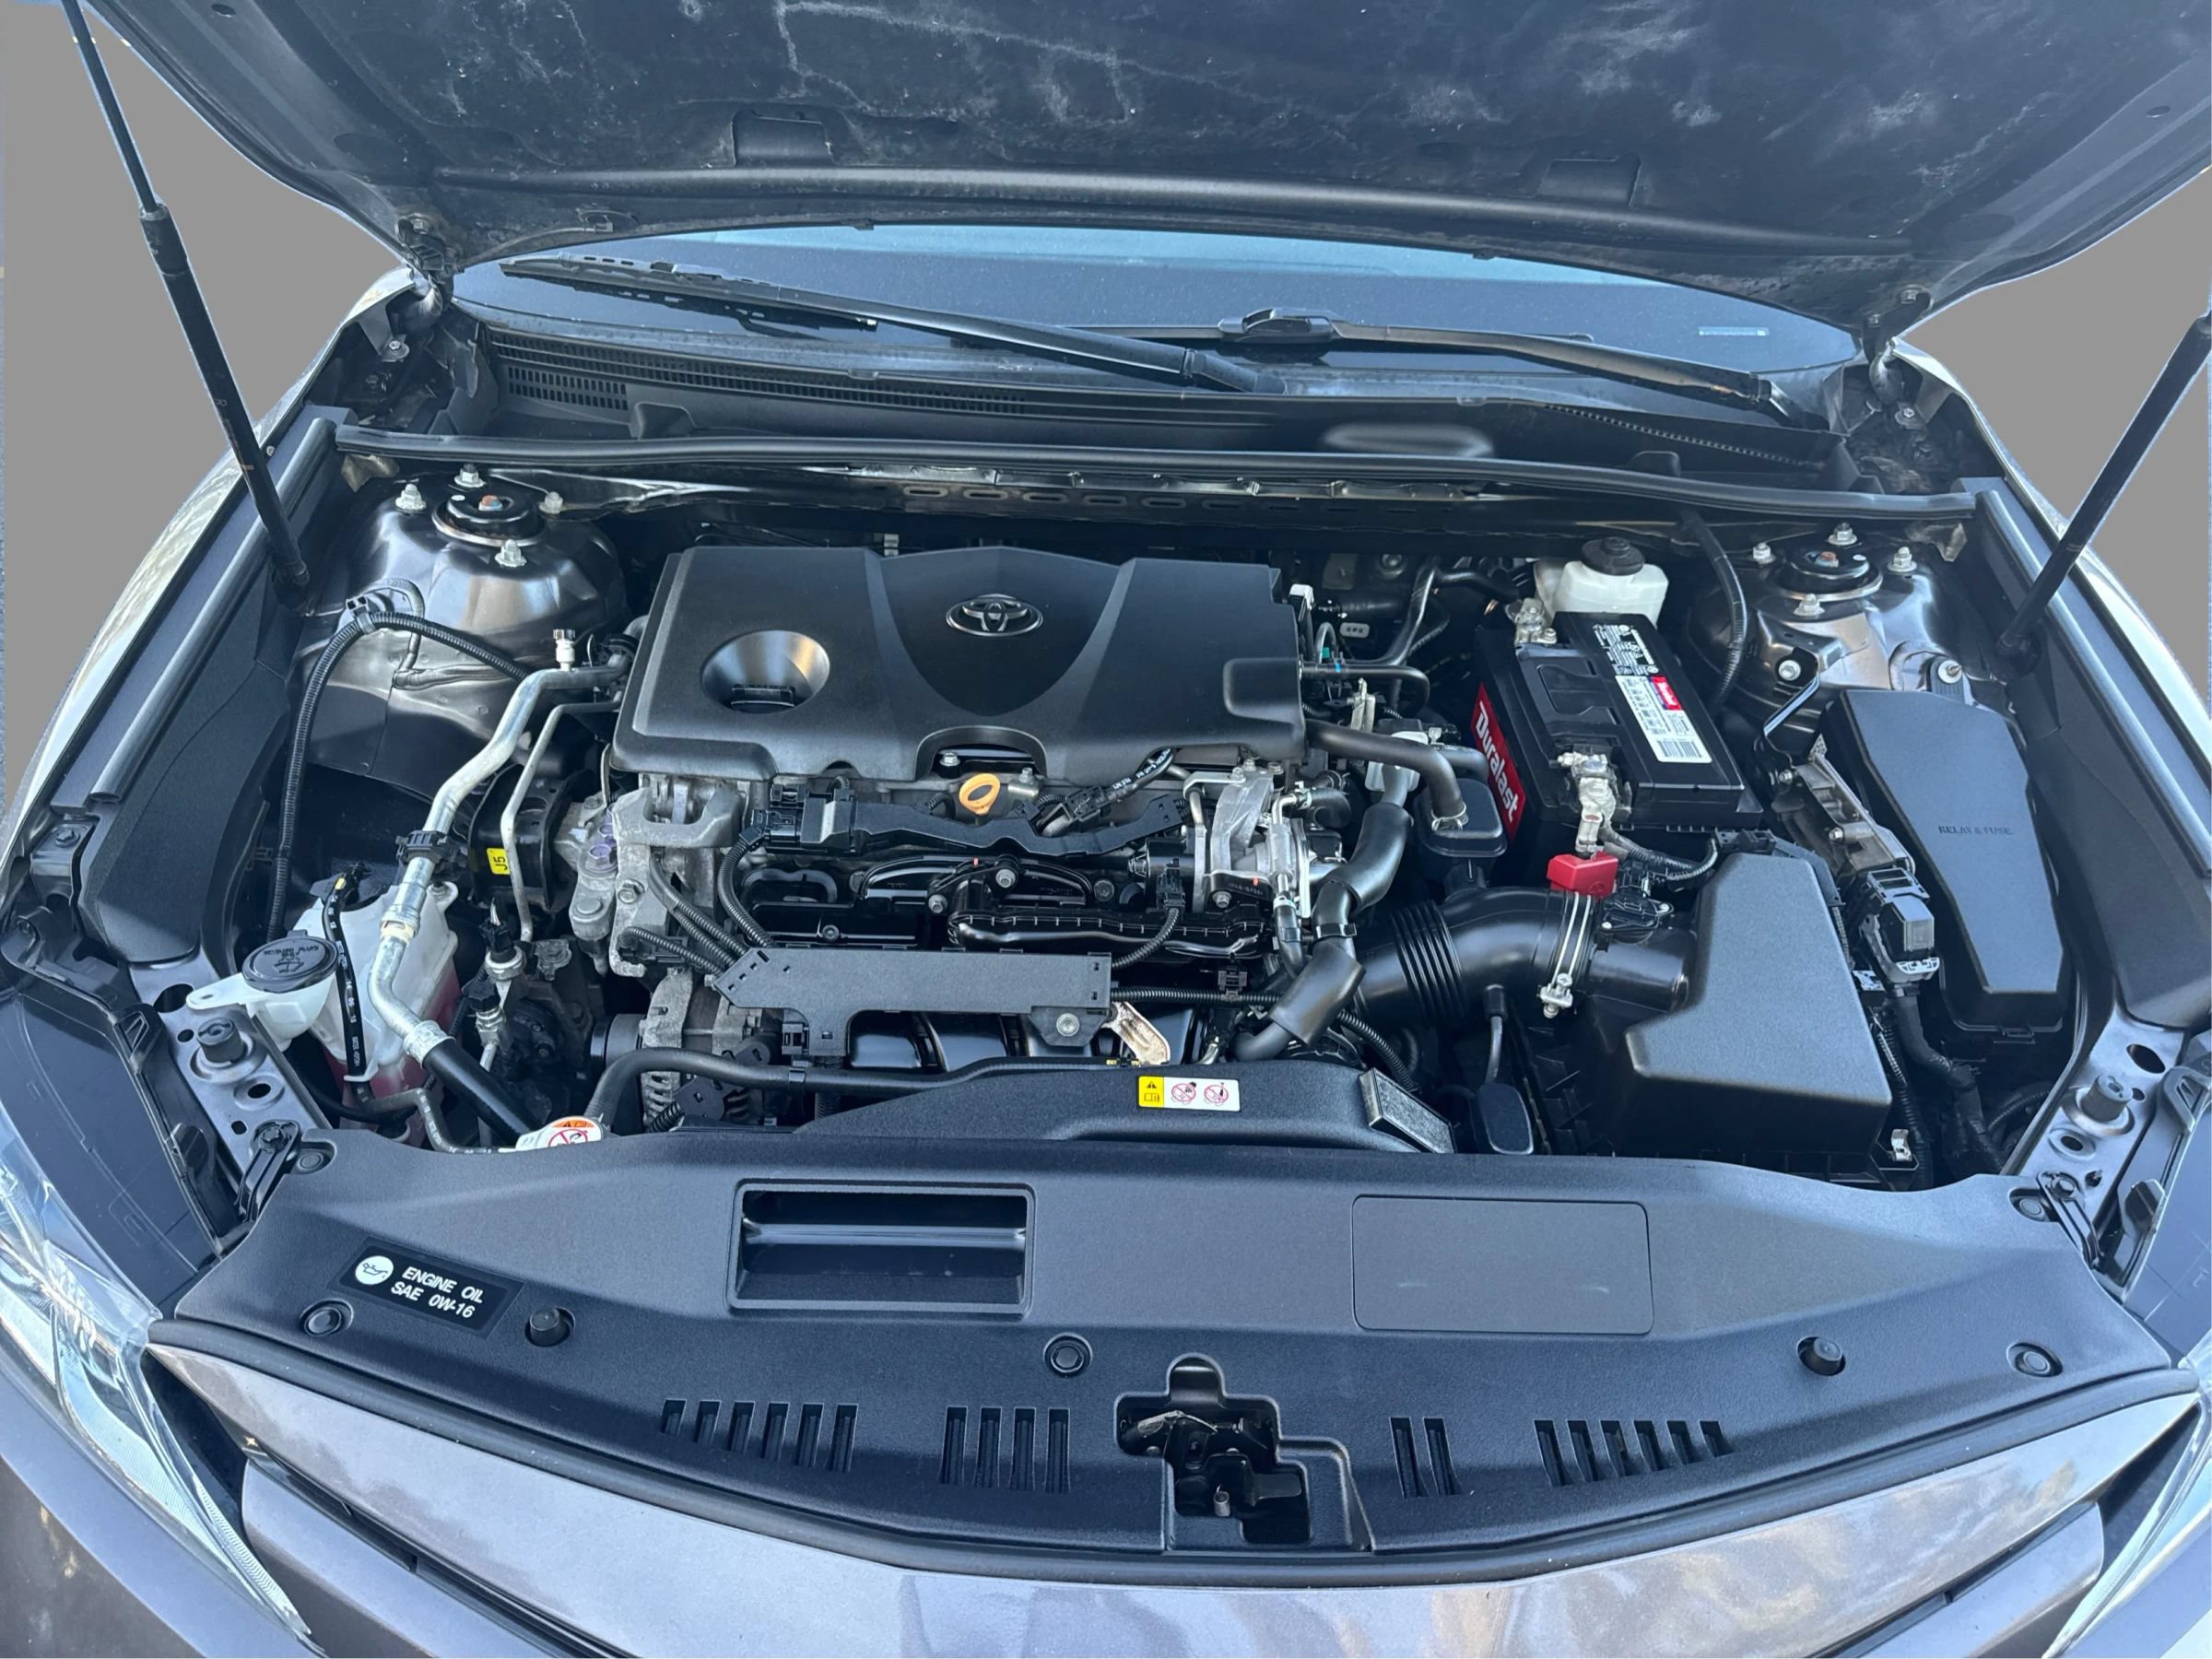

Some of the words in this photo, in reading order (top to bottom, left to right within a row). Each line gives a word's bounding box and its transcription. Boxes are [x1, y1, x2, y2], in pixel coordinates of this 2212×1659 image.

[1476, 700, 1519, 823] Duralast
[1938, 826, 1971, 834] RELAY
[1983, 826, 2013, 835] FUSE
[391, 1281, 424, 1301] SAE
[428, 1294, 476, 1319] 0W-16
[402, 1266, 457, 1293] ENGINE
[461, 1286, 484, 1303] OIL
